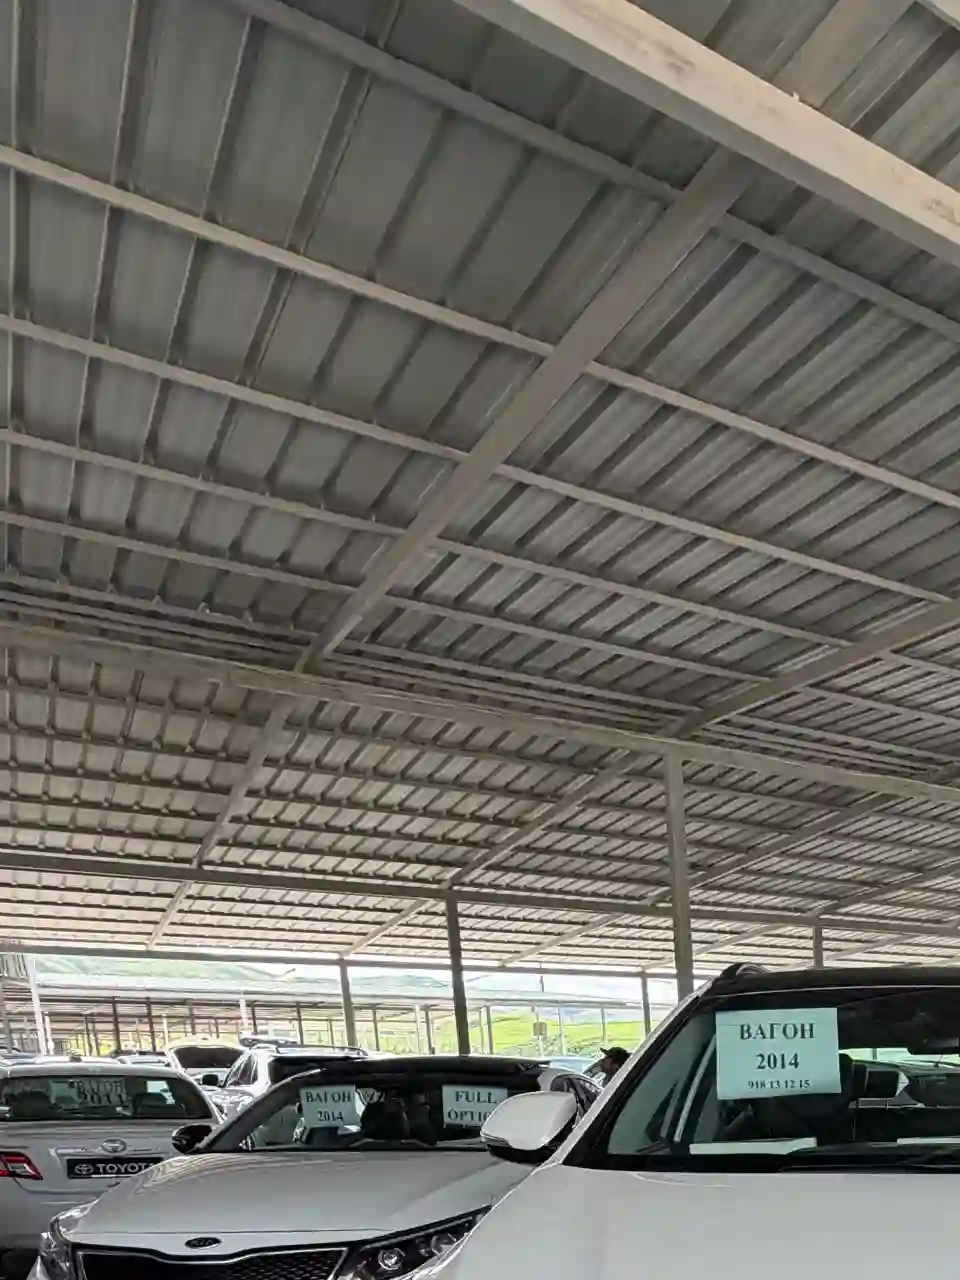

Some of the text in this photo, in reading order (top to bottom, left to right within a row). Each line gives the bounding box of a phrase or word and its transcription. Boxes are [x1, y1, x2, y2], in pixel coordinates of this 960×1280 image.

[740, 1022, 816, 1040] ВАГОН
[756, 1052, 800, 1070] 2014
[769, 1080, 781, 1088] 13
[784, 1080, 796, 1088] 12
[799, 1079, 810, 1088] 15
[305, 1090, 351, 1103] ВАГОН
[455, 1090, 497, 1104] FULL
[317, 1110, 344, 1122] 2014
